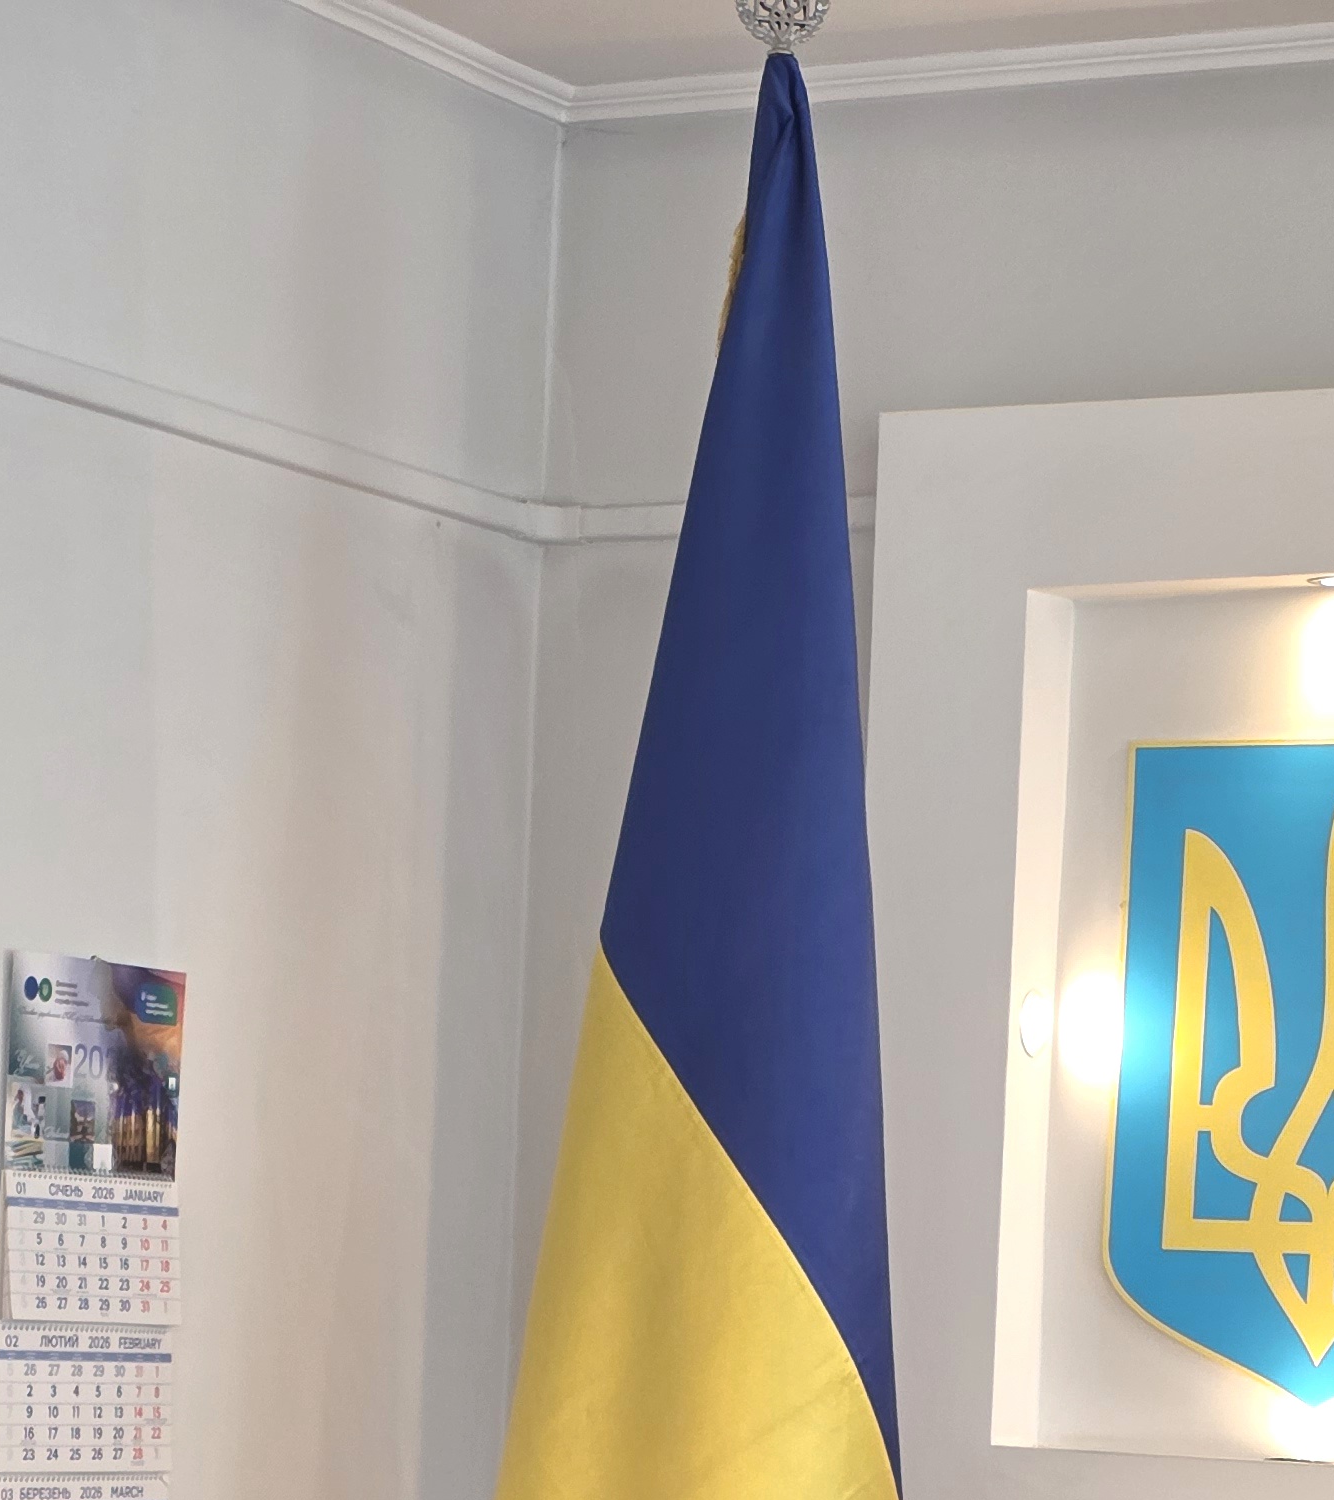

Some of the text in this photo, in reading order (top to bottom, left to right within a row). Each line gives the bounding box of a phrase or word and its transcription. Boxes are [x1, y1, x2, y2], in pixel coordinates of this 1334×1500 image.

[16, 1181, 165, 1203] 01 СІЧЕНЬ 2026 JANUARY
[54, 1212, 67, 1225] 30
[101, 1215, 106, 1228] 1
[121, 1217, 128, 1229] 2
[142, 1218, 148, 1230] 3
[161, 1219, 168, 1231] 4
[36, 1232, 43, 1245] 5
[57, 1233, 65, 1247] 6
[79, 1235, 86, 1247] 7
[100, 1236, 107, 1249] 8
[121, 1237, 128, 1250] 9
[139, 1238, 151, 1251] 10
[160, 1239, 169, 1252] 11
[35, 1253, 46, 1266] 12
[56, 1254, 67, 1268] 13
[77, 1256, 87, 1269] 14
[98, 1257, 109, 1270] 15
[119, 1258, 130, 1271] 16
[140, 1259, 150, 1272] 17
[160, 1260, 170, 1273] 18
[35, 1274, 46, 1288] 19
[55, 1276, 68, 1289] 20
[77, 1277, 87, 1290] 21
[98, 1278, 110, 1291] 22
[118, 1279, 130, 1292] 23
[139, 1280, 151, 1293] 24
[35, 1296, 47, 1309] 26
[56, 1297, 68, 1310] 27
[78, 1298, 90, 1310] 28
[98, 1298, 110, 1311] 29
[119, 1299, 131, 1312] 30
[4, 1334, 162, 1350] 02 ЛЮТИЙ 2026 FEBRUARY
[114, 1365, 126, 1377] 30
[26, 1385, 33, 1397] 2
[50, 1385, 57, 1398] 3
[73, 1385, 80, 1397] 4
[95, 1385, 102, 1398] 5
[116, 1385, 123, 1398] 6
[135, 1386, 142, 1398] 7
[26, 1406, 33, 1419] 9
[48, 1406, 59, 1419] 10
[72, 1406, 80, 1419] 11
[93, 1406, 103, 1419] 12
[114, 1406, 124, 1419] 13
[134, 1407, 143, 1418] 14
[152, 1407, 161, 1419] 15
[24, 1427, 35, 1440] 16
[48, 1427, 59, 1440] 17
[71, 1427, 81, 1440] 18
[93, 1427, 103, 1440] 19
[113, 1427, 125, 1440] 20
[151, 1427, 162, 1439] 22
[22, 1448, 36, 1461] 23
[46, 1448, 59, 1461] 24
[69, 1448, 81, 1461] 25
[91, 1448, 103, 1461] 26
[112, 1448, 124, 1460] 27
[0, 1486, 144, 1500] 03 БЕРЕЗЕНЬ 2026 MARCH
